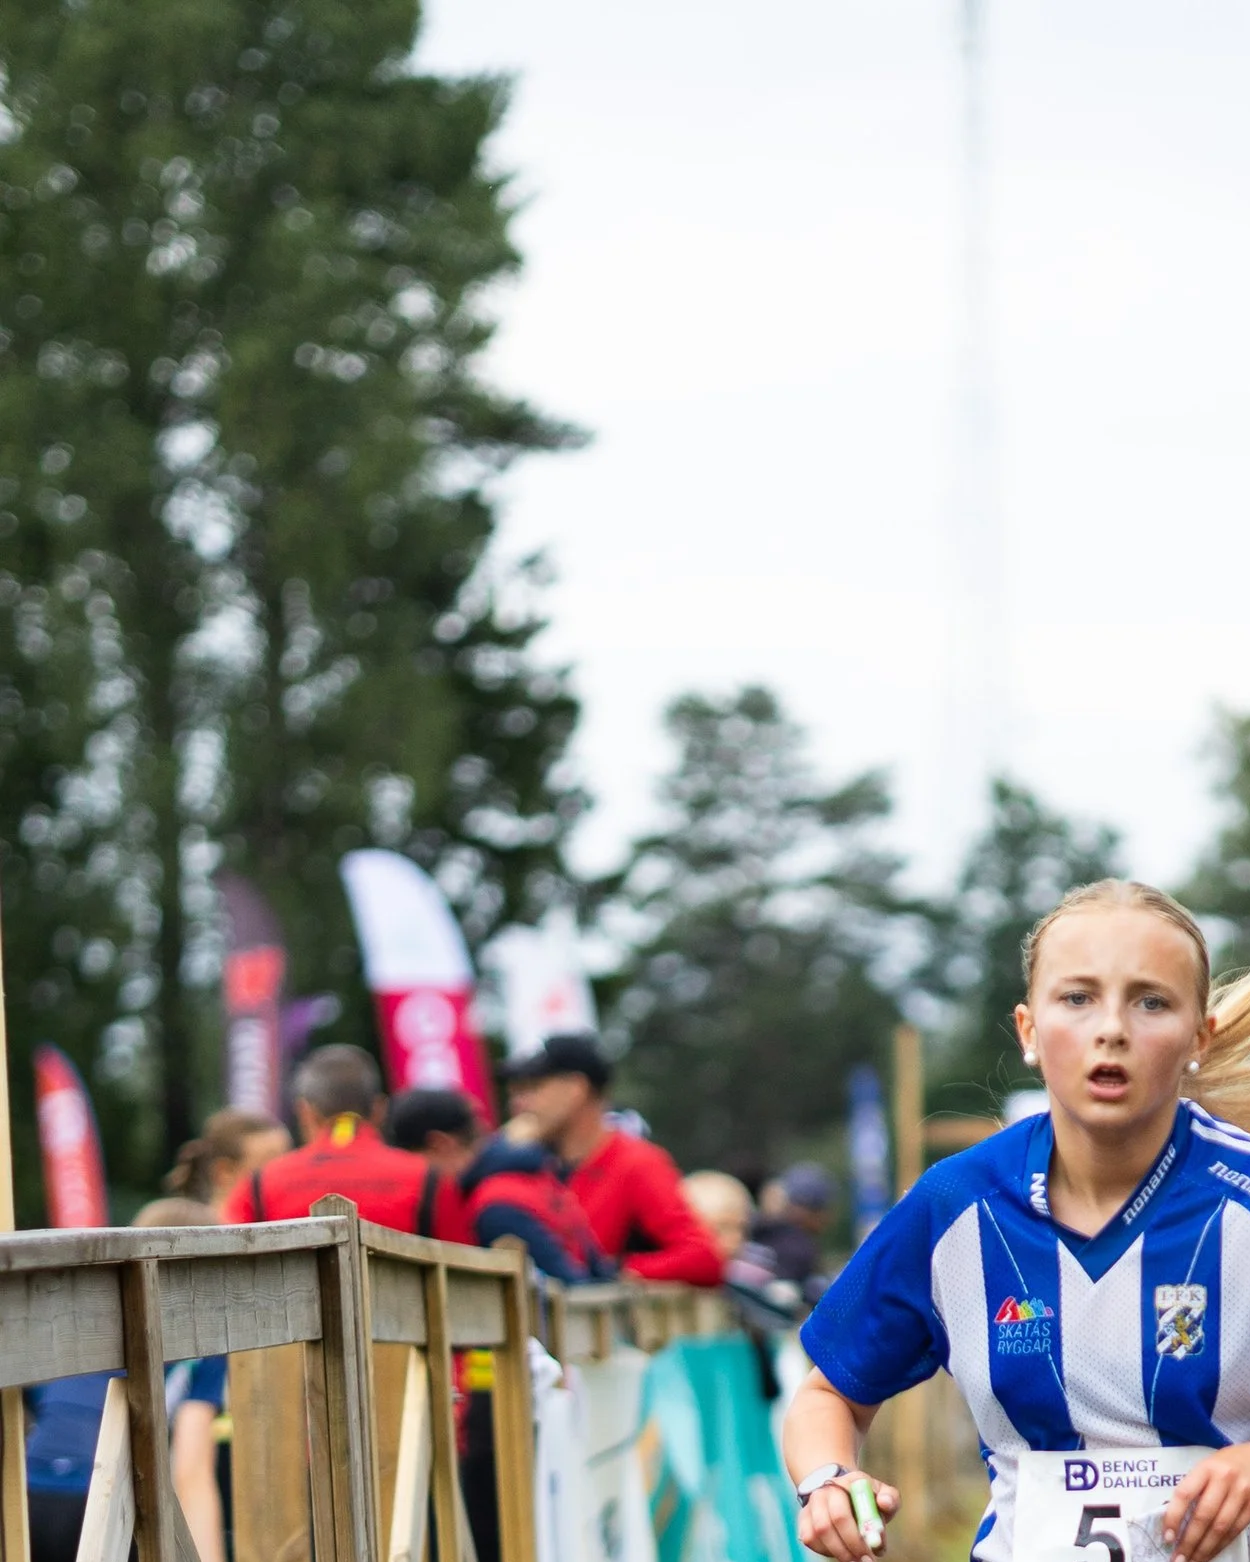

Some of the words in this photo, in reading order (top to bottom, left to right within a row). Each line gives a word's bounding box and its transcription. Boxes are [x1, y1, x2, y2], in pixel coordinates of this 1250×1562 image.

[1122, 1143, 1177, 1226] noname
[997, 1338, 1052, 1355] RYGGAR
[1102, 1460, 1158, 1473] BENGT
[1103, 1474, 1187, 1489] DAHLGRE
